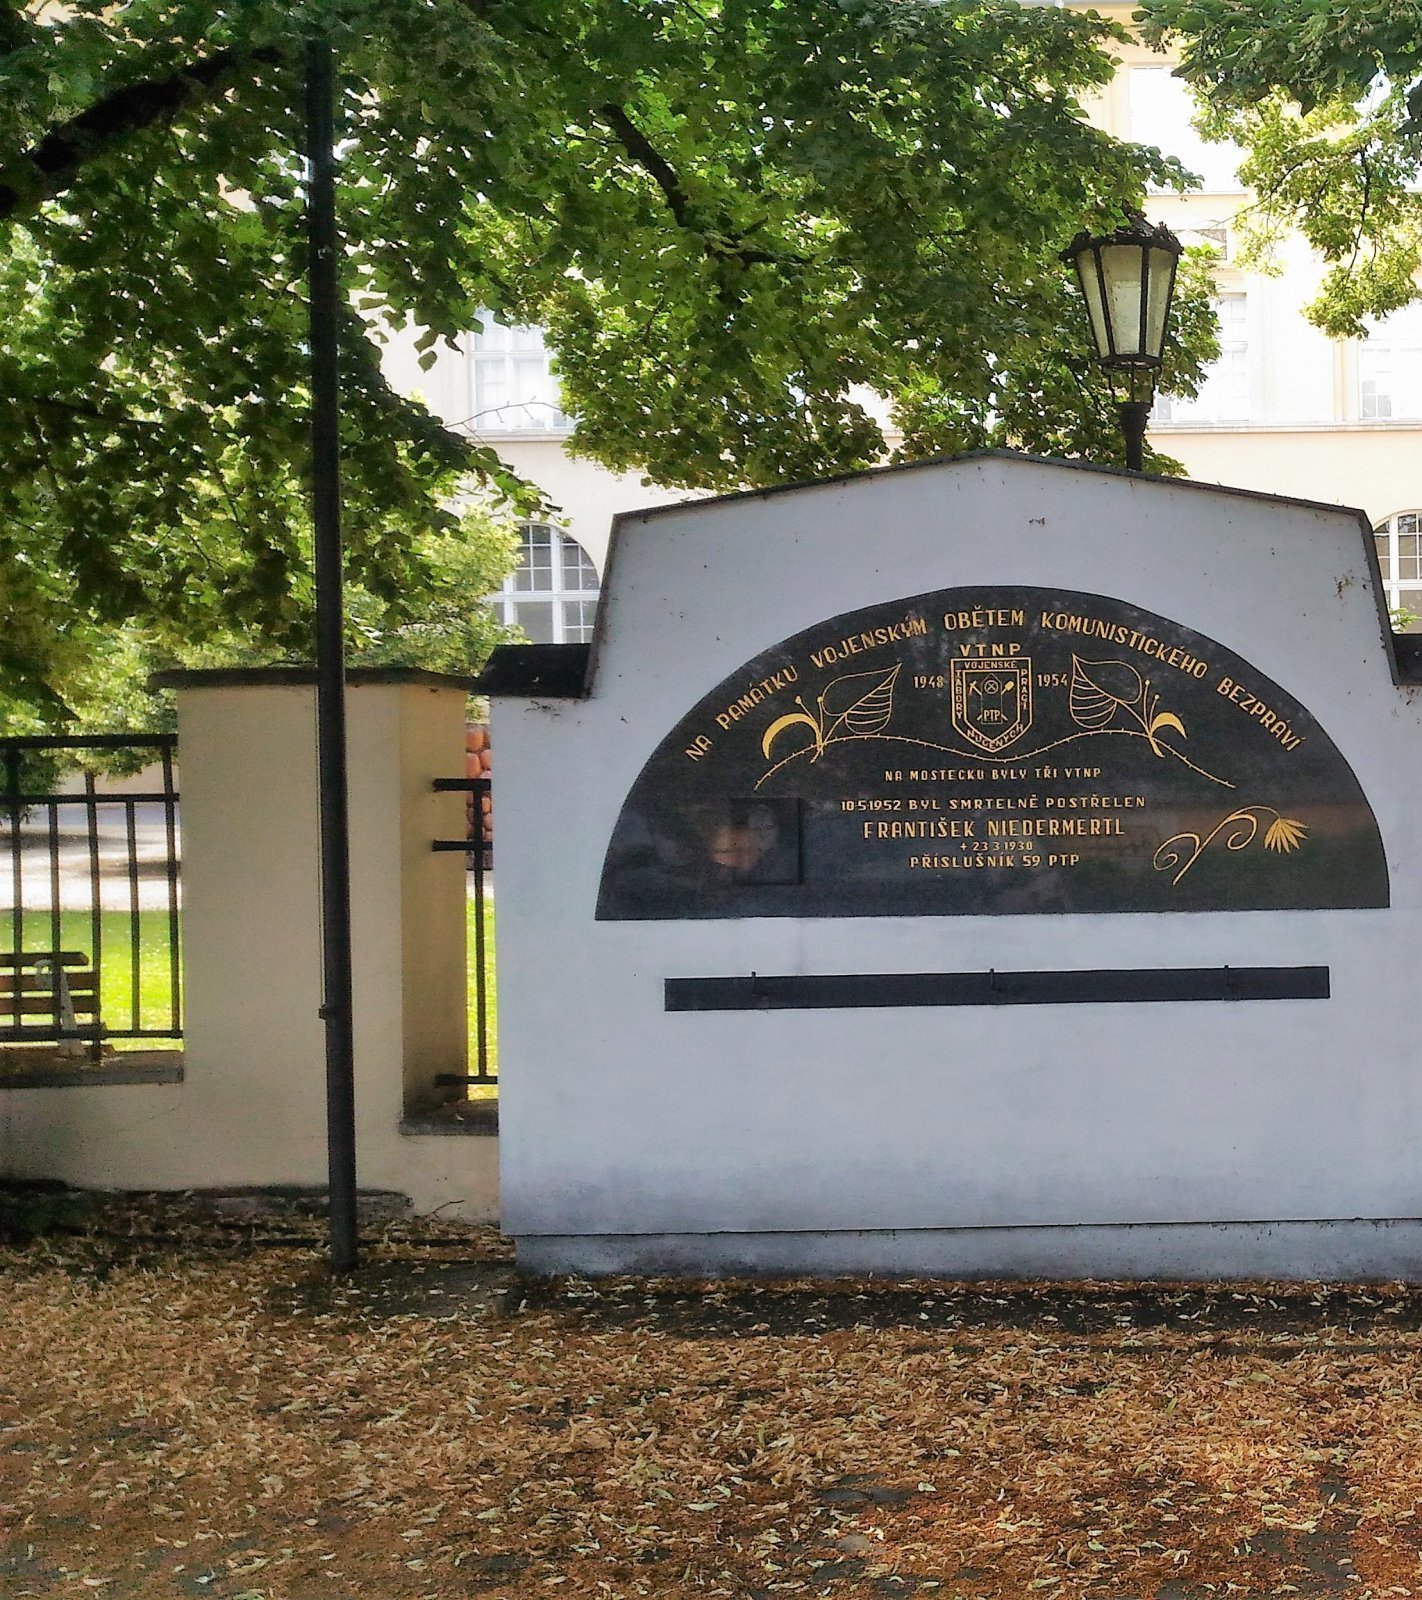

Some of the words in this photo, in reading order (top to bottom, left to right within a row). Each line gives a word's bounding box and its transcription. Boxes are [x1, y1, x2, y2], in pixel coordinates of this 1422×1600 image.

[959, 643, 1022, 657] VTNP
[684, 734, 713, 763] NA
[714, 664, 799, 730] PAMÁTKU
[810, 613, 927, 669] VOJENSKÝM
[944, 605, 1023, 631] OBĚTEM
[1041, 610, 1208, 679] KOMUNISTICKÉHO
[1216, 676, 1307, 753] BEZPRÁVÍ
[913, 676, 945, 689] 1948
[1037, 673, 1069, 687] 1954
[983, 709, 1001, 721] PTP
[885, 770, 902, 782] NA
[909, 769, 984, 782] MOSTECKU
[992, 768, 1027, 780] BYLY
[1034, 765, 1057, 779] TŘI
[1064, 767, 1101, 779] VTNP
[908, 799, 941, 811] BYL
[949, 795, 1039, 811] SMRTELNĚ
[1045, 794, 1146, 809] POSTŘELEN
[863, 817, 975, 839] FRANTIŠEK
[987, 817, 1126, 837] NIEDERMERTL
[1004, 841, 1033, 851] 1930
[909, 852, 1015, 869] PŘÍSLUŠNÍK
[1022, 854, 1041, 868] 59
[1048, 854, 1080, 867] PTP
